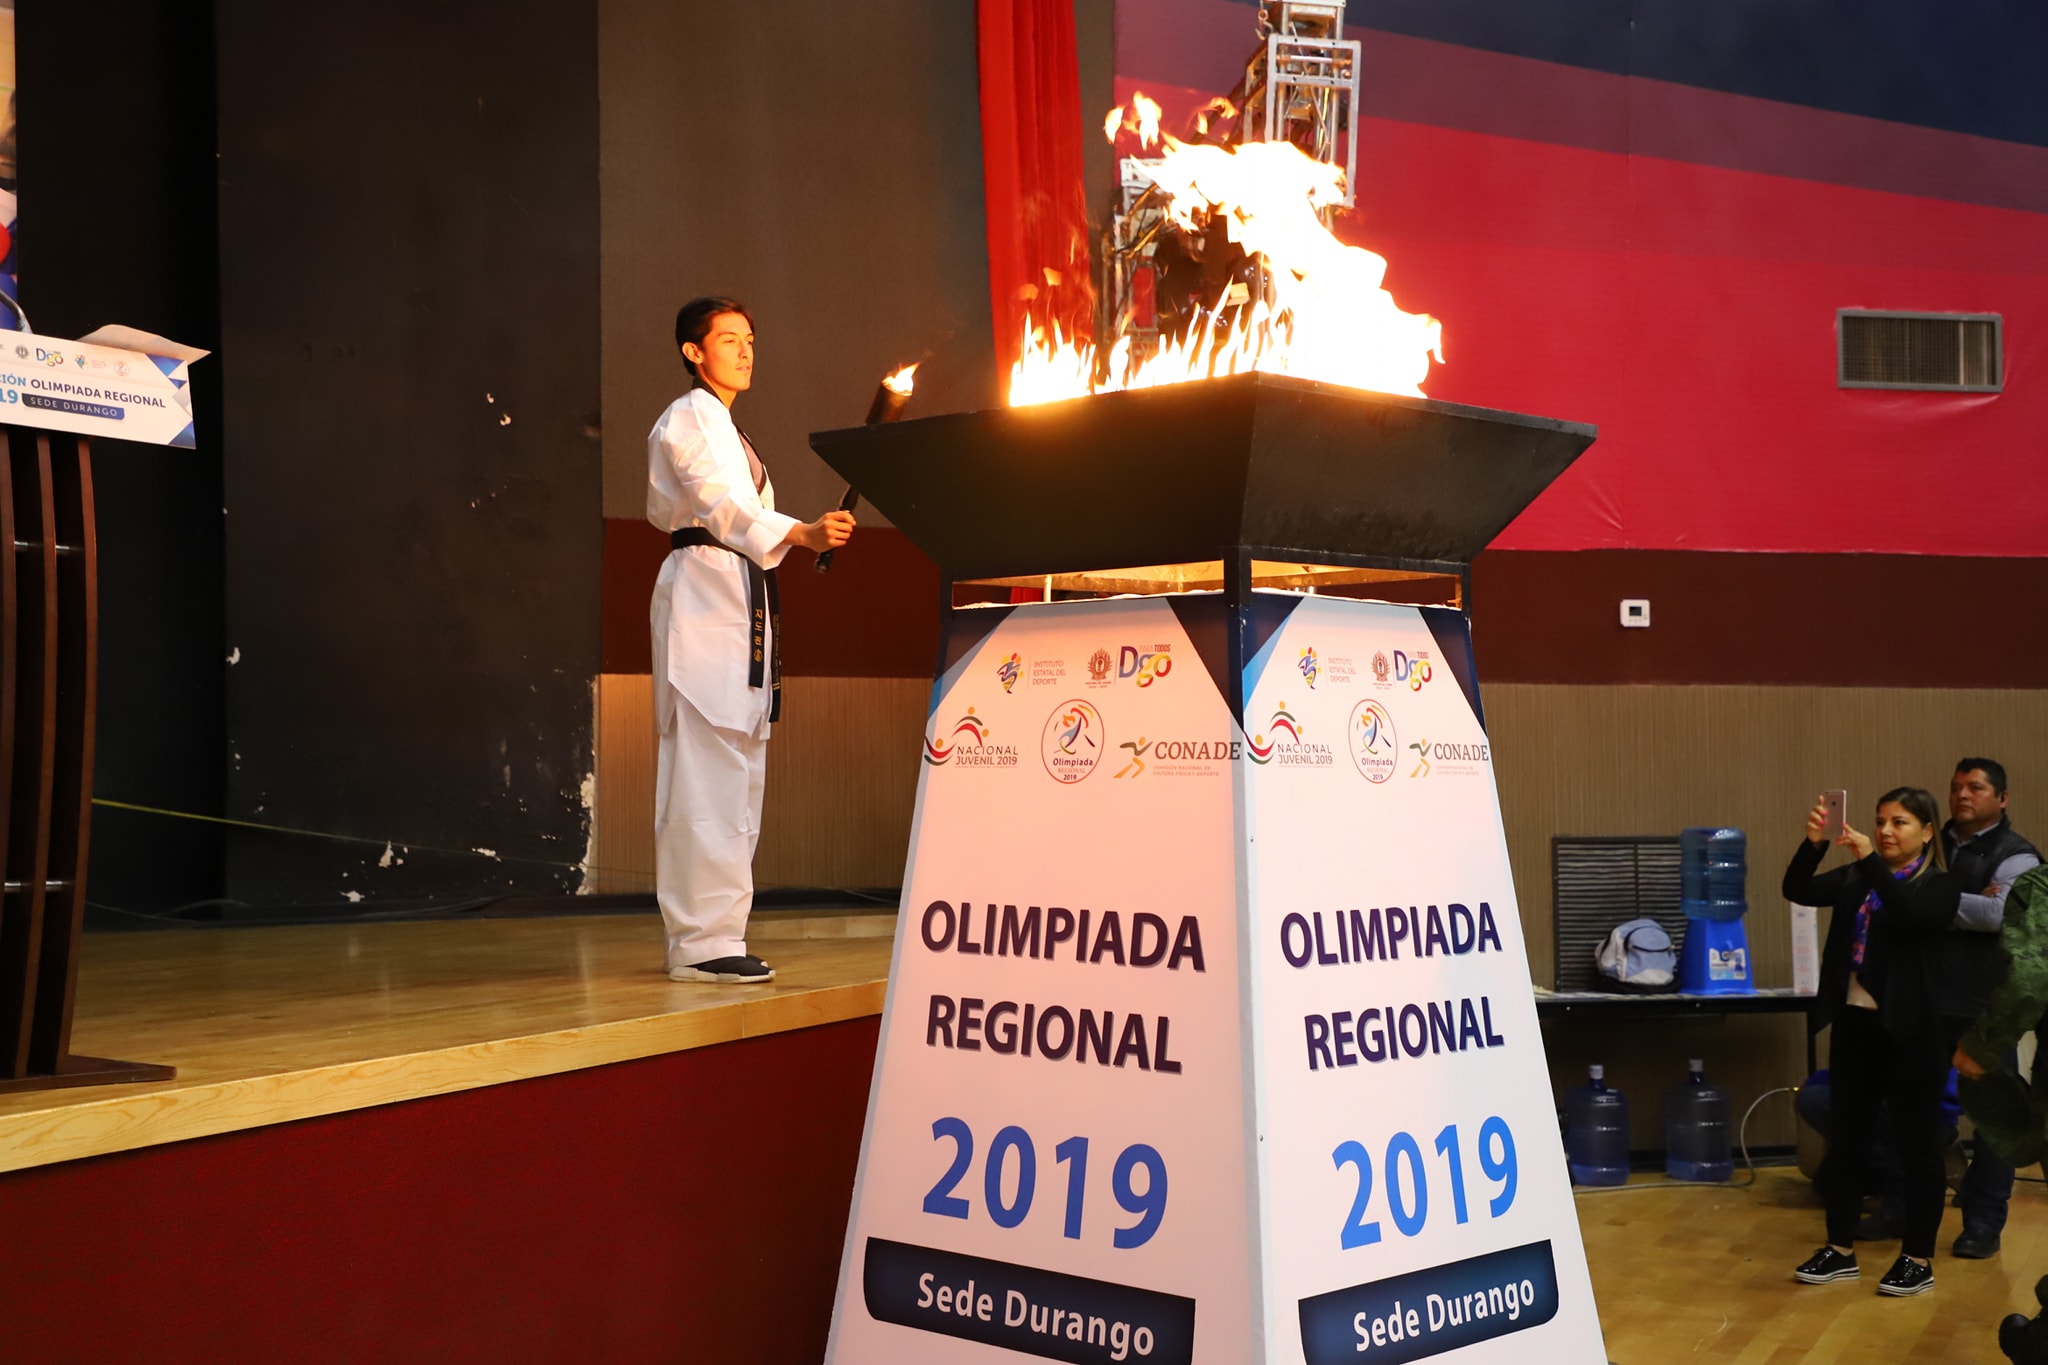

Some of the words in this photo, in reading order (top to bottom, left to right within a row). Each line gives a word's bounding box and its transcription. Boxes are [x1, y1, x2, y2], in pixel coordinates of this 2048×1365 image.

[0, 373, 26, 387] IÓN
[31, 379, 101, 398] OLIMPIADA
[104, 390, 166, 408] REGIONAL
[30, 397, 58, 408] SEDE
[63, 401, 118, 417] DURANGO
[955, 756, 994, 766] JUVENIL
[997, 756, 1018, 765] 2019
[957, 745, 1018, 755] NACIONAL
[1155, 741, 1241, 760] CONADE
[1278, 743, 1332, 754] NACIONAL
[1279, 755, 1314, 764] JUVENIL
[1316, 755, 1333, 765] 2019
[1362, 757, 1393, 766] Olimpiada
[1434, 743, 1489, 761] CONADE
[1053, 758, 1093, 767] Olimpiada
[921, 900, 1206, 973] OLIMPIADA
[1280, 902, 1502, 969] OLIMPIADA
[926, 994, 1182, 1075] REGIONAL
[1304, 996, 1505, 1072] REGIONAL
[922, 1116, 1168, 1250] 2019
[1331, 1115, 1518, 1250] 2019
[917, 1272, 994, 1322] Sede
[1004, 1289, 1155, 1361] Durango
[1353, 1301, 1421, 1352] Sede
[1426, 1278, 1535, 1332] Durango
